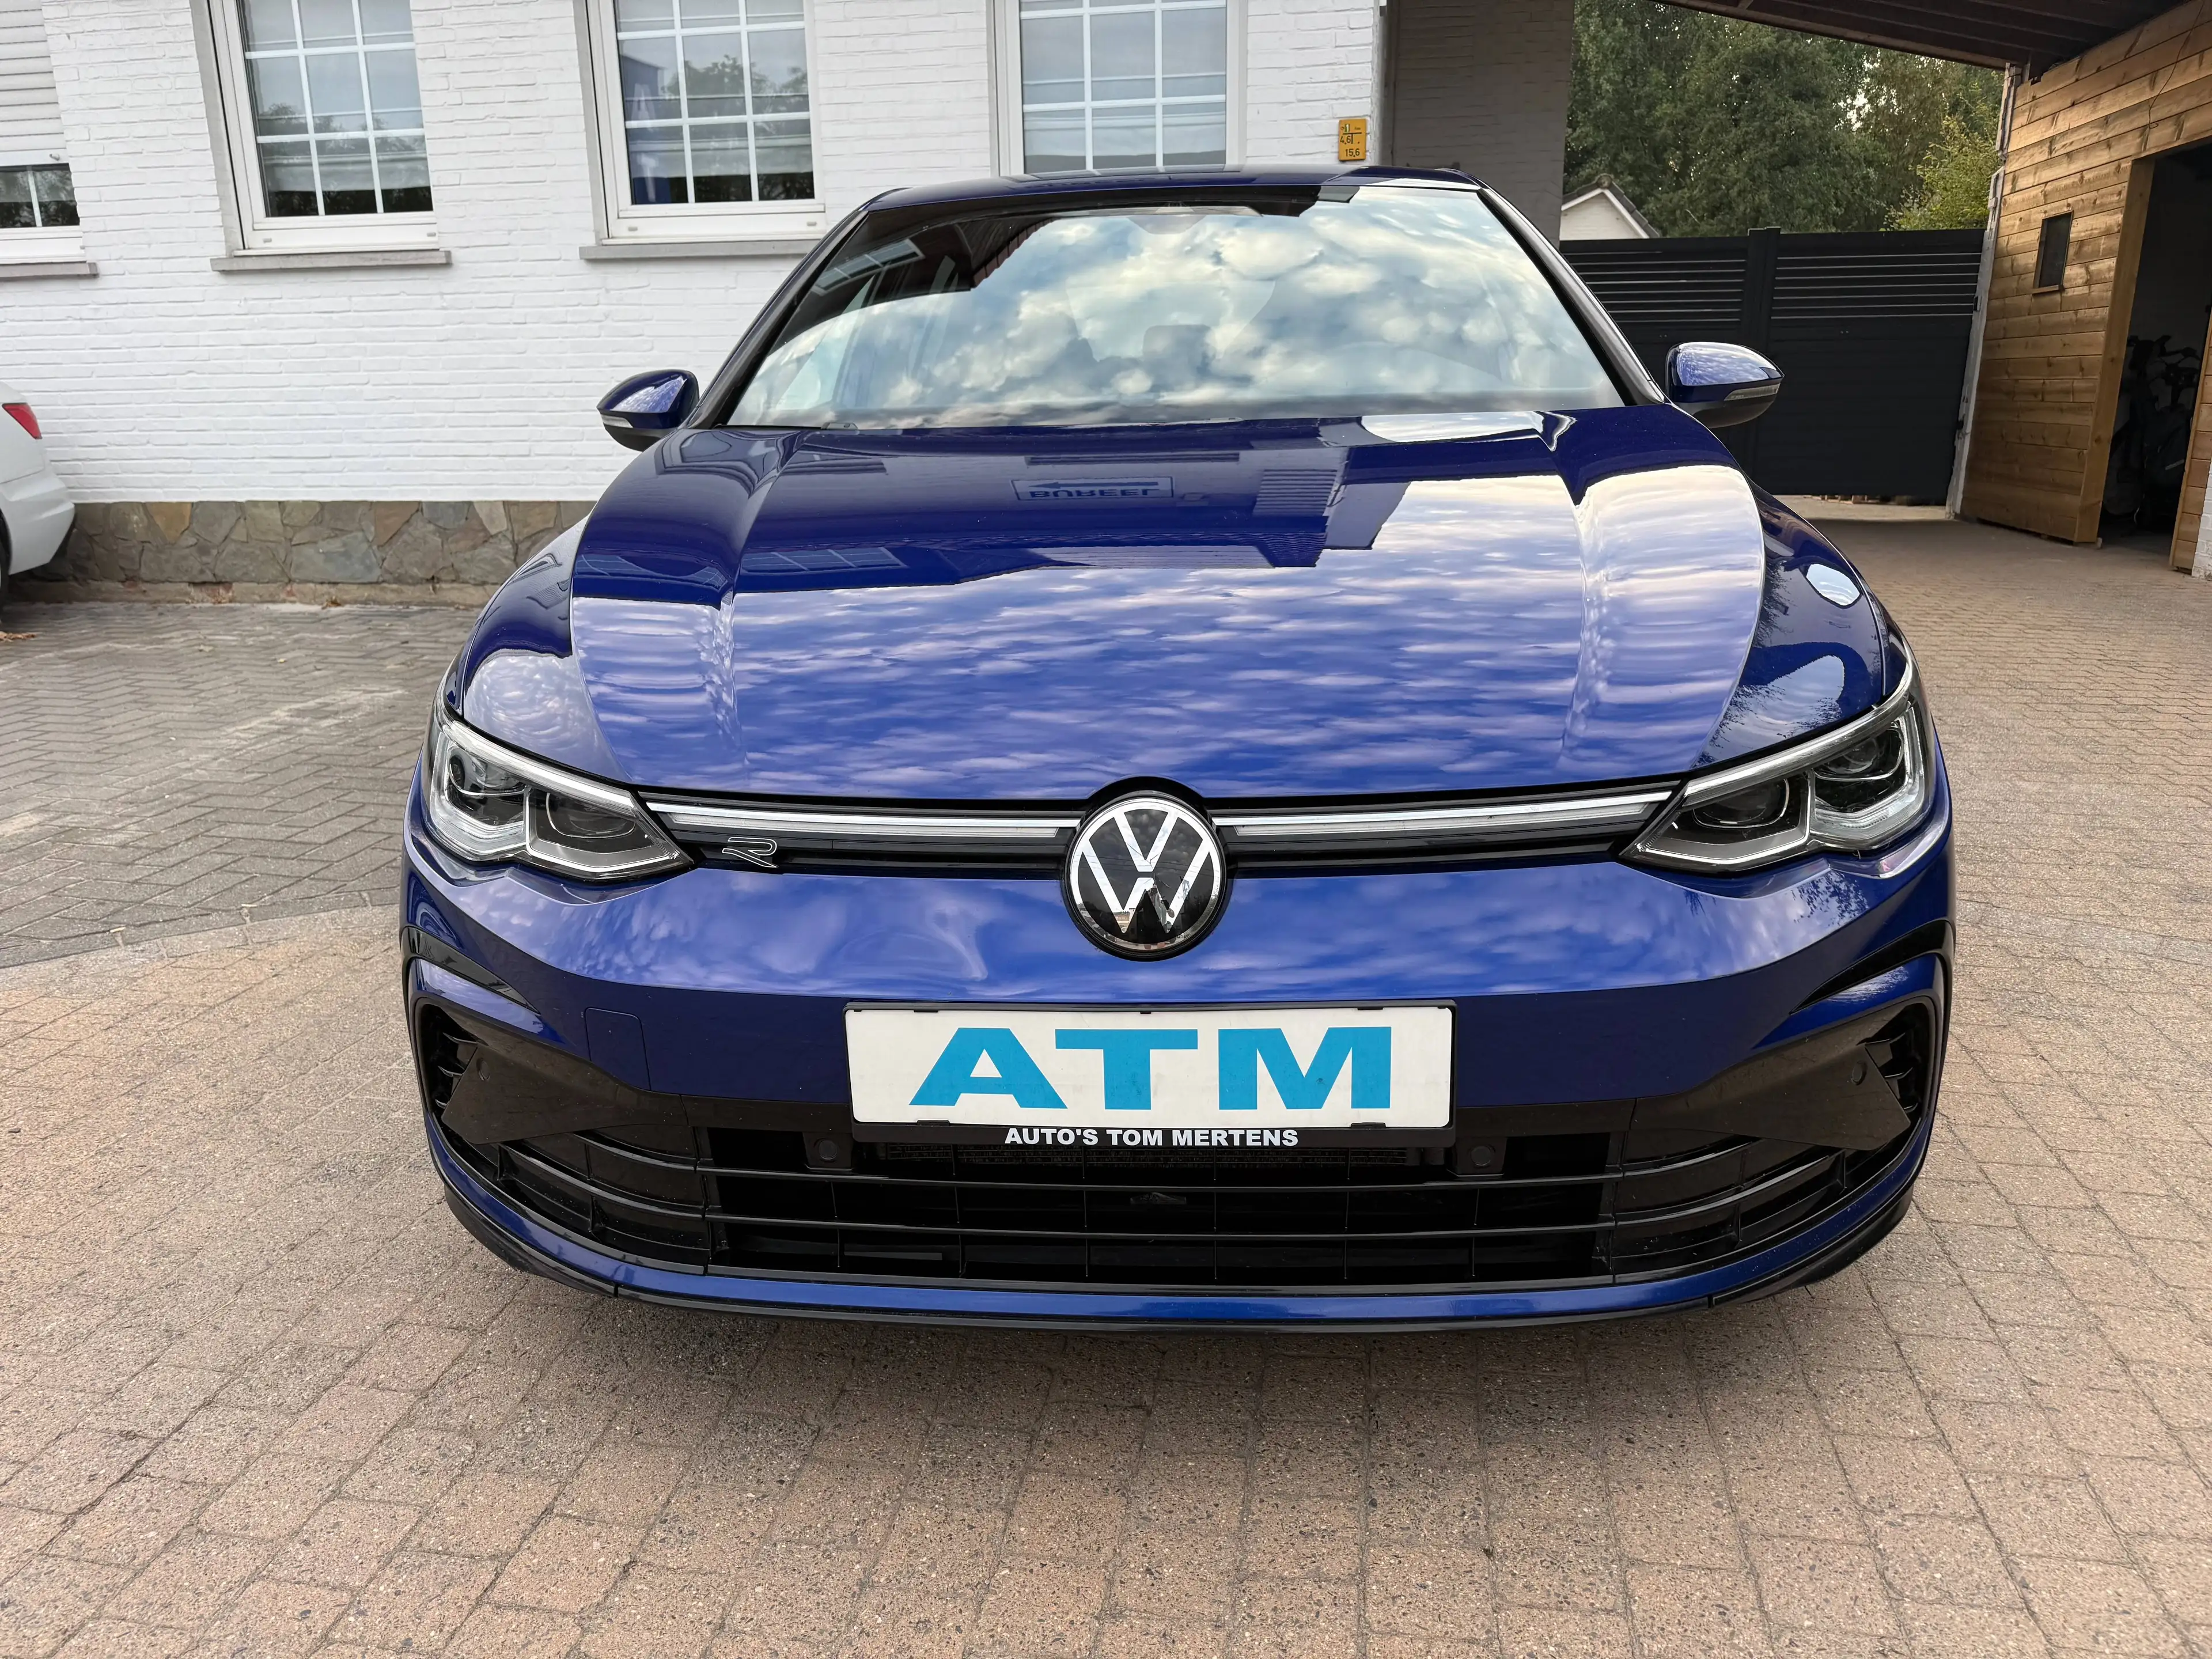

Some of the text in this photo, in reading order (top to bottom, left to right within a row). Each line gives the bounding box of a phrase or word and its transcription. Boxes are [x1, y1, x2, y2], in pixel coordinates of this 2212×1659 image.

[1346, 148, 1360, 157] 15.6
[910, 1027, 1392, 1111] ATM
[1005, 1127, 1298, 1146] AUTO'S TOM MERTENS
